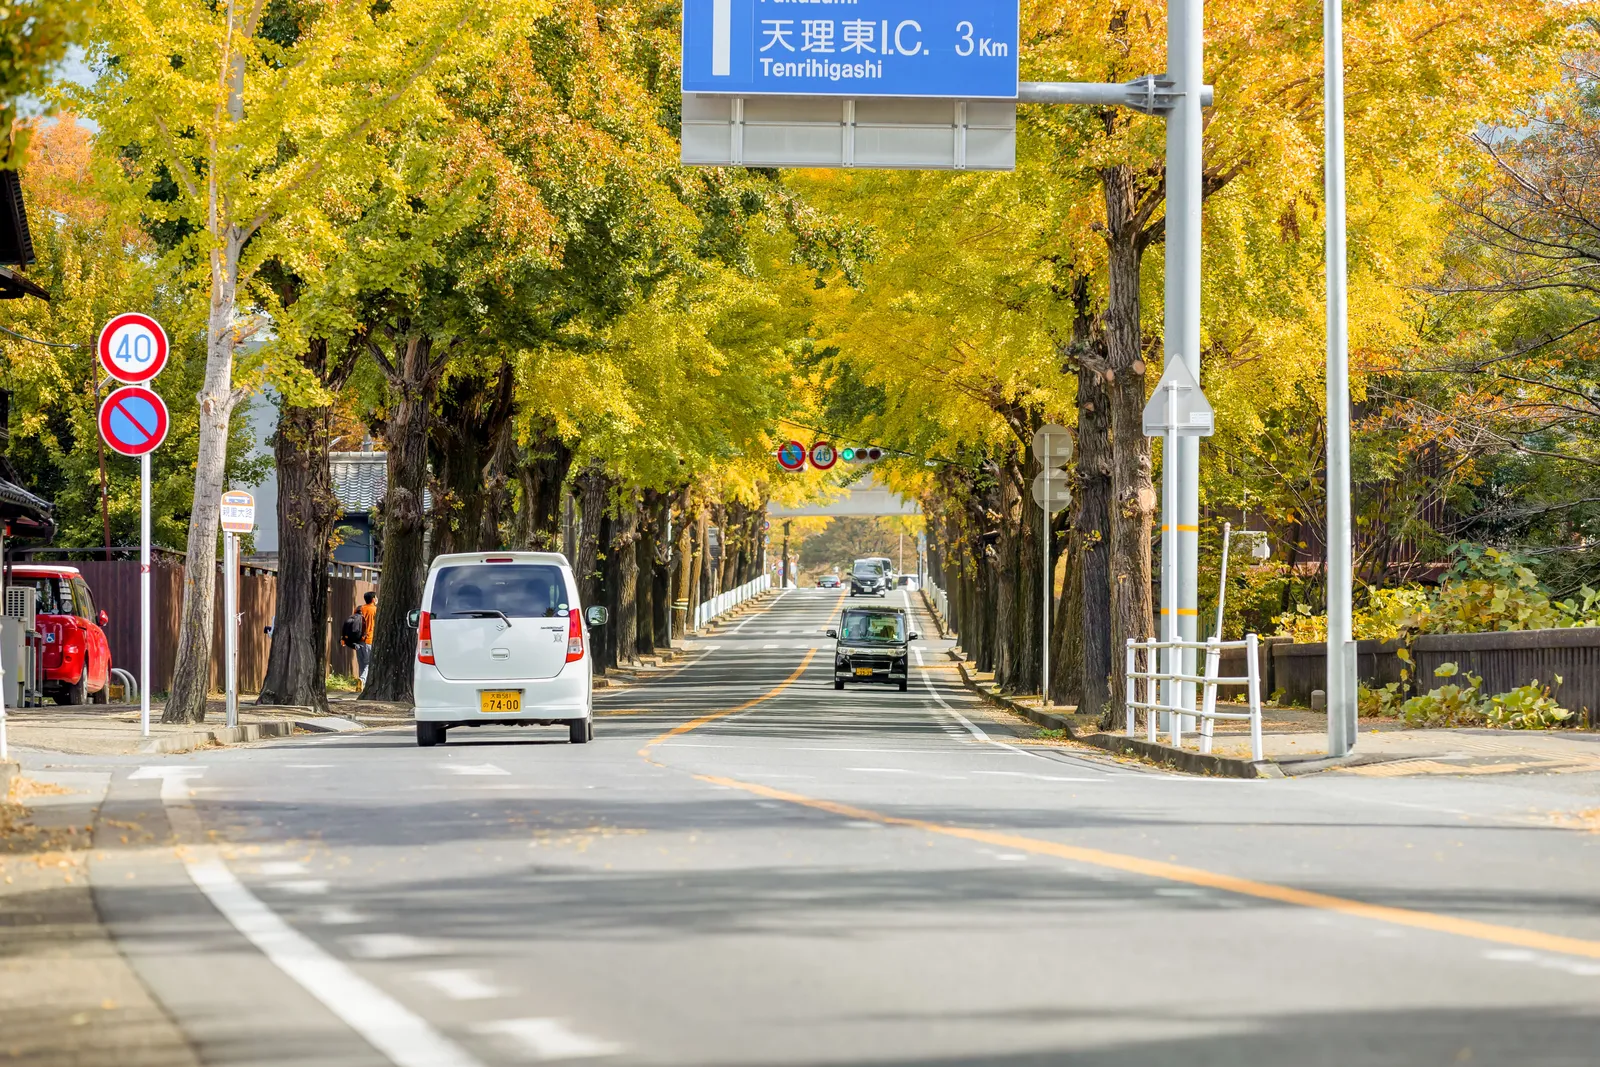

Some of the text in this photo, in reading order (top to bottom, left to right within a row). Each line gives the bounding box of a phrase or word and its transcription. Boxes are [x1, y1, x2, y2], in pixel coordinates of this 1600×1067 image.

[954, 21, 975, 57] 3
[979, 38, 1009, 57] Km
[759, 57, 883, 81] Tenrihigashi
[115, 333, 152, 363] 40
[815, 449, 832, 462] 40
